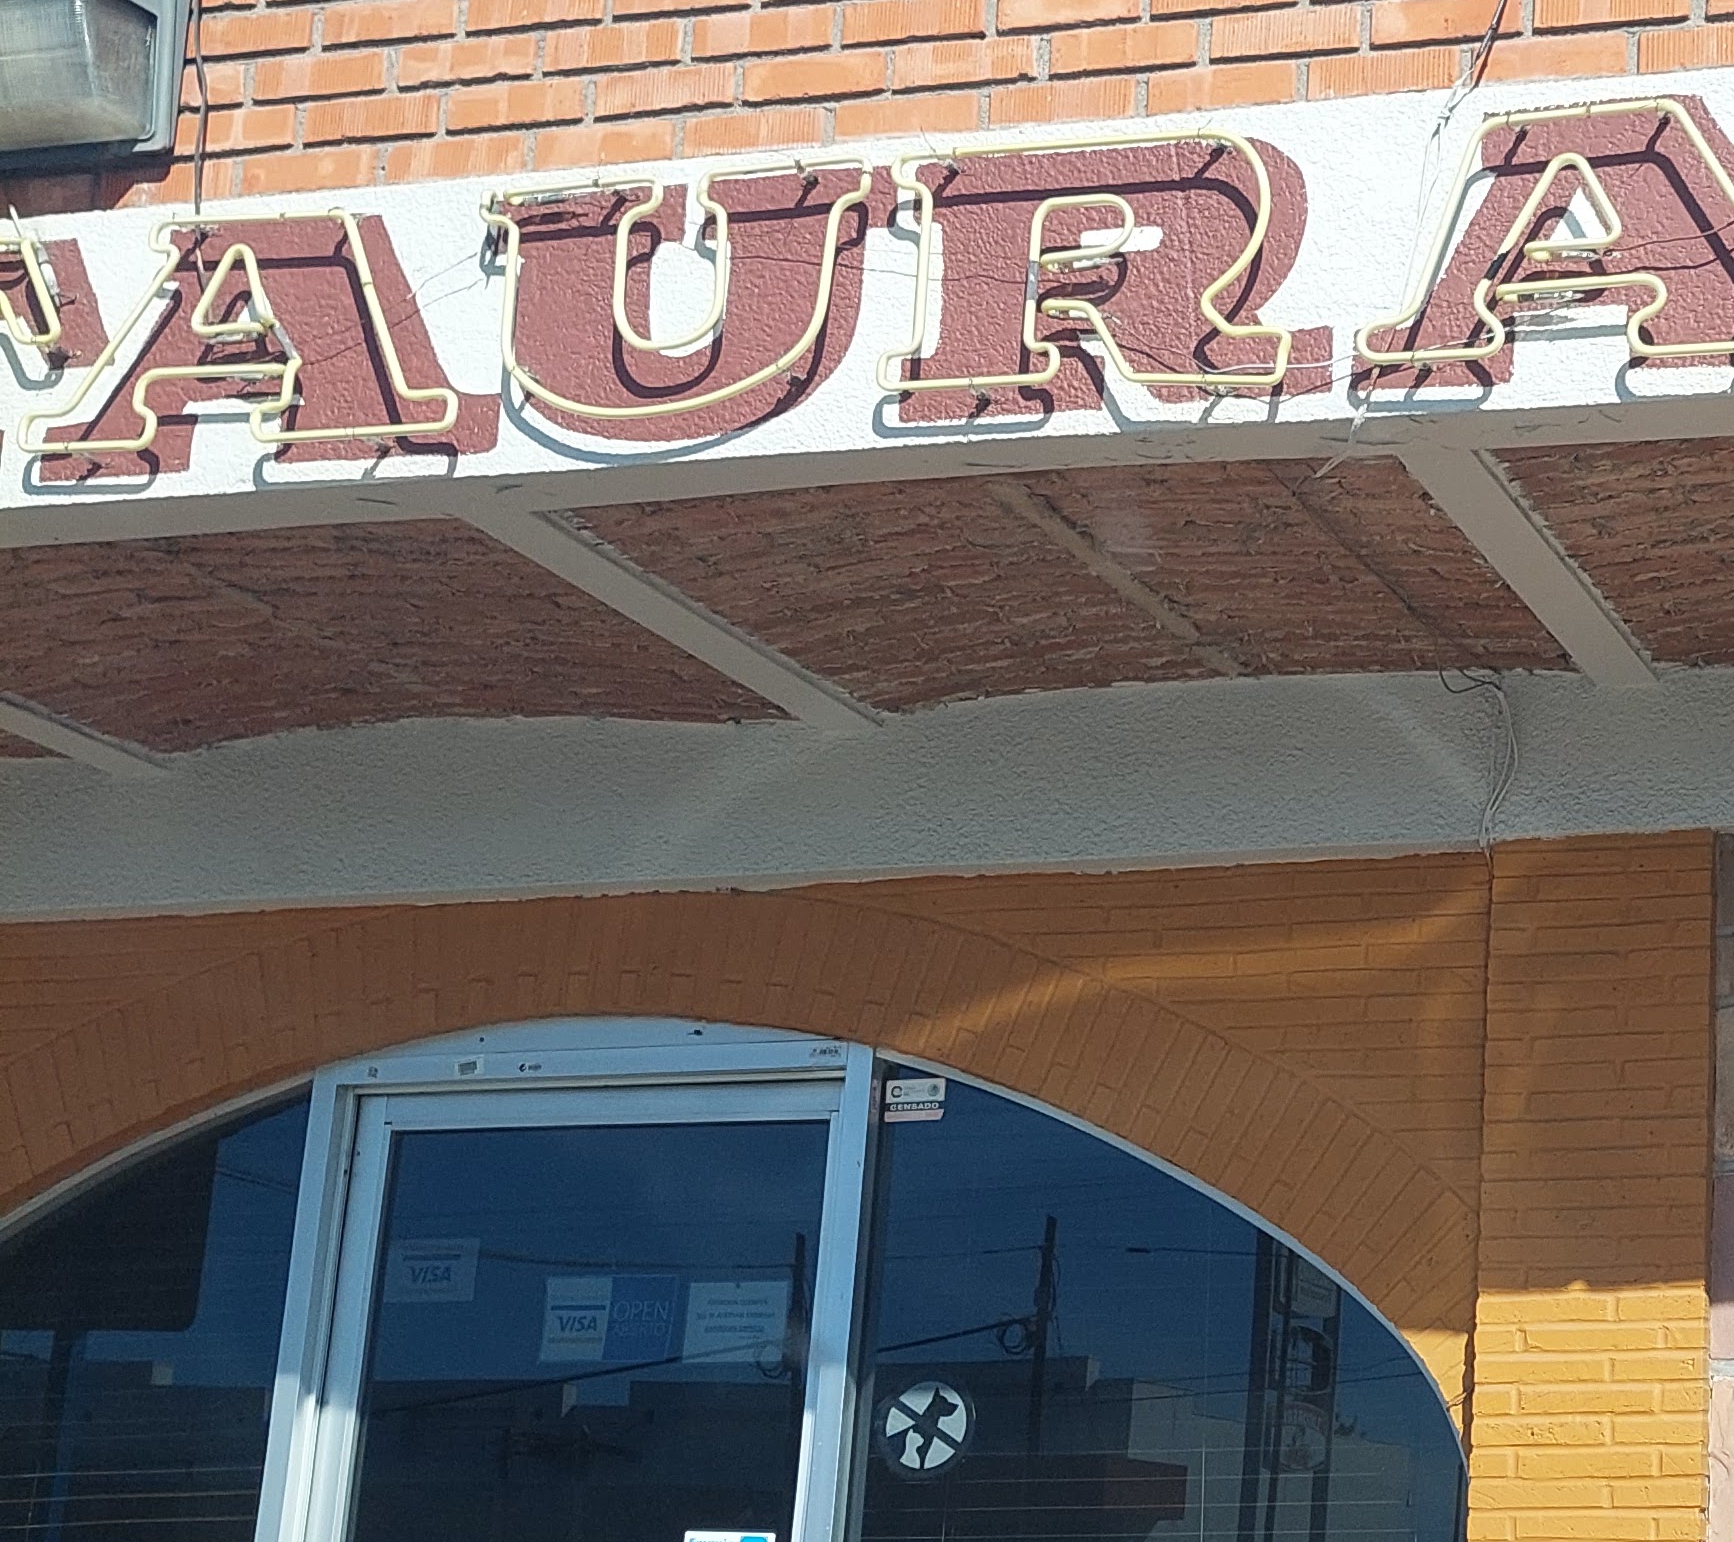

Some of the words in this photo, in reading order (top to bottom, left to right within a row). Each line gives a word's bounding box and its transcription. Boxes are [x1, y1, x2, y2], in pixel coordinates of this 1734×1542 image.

[889, 1102, 940, 1111] CENSADO
[410, 1266, 452, 1284] VISA
[613, 1300, 669, 1321] OPEN
[558, 1316, 598, 1332] VISA
